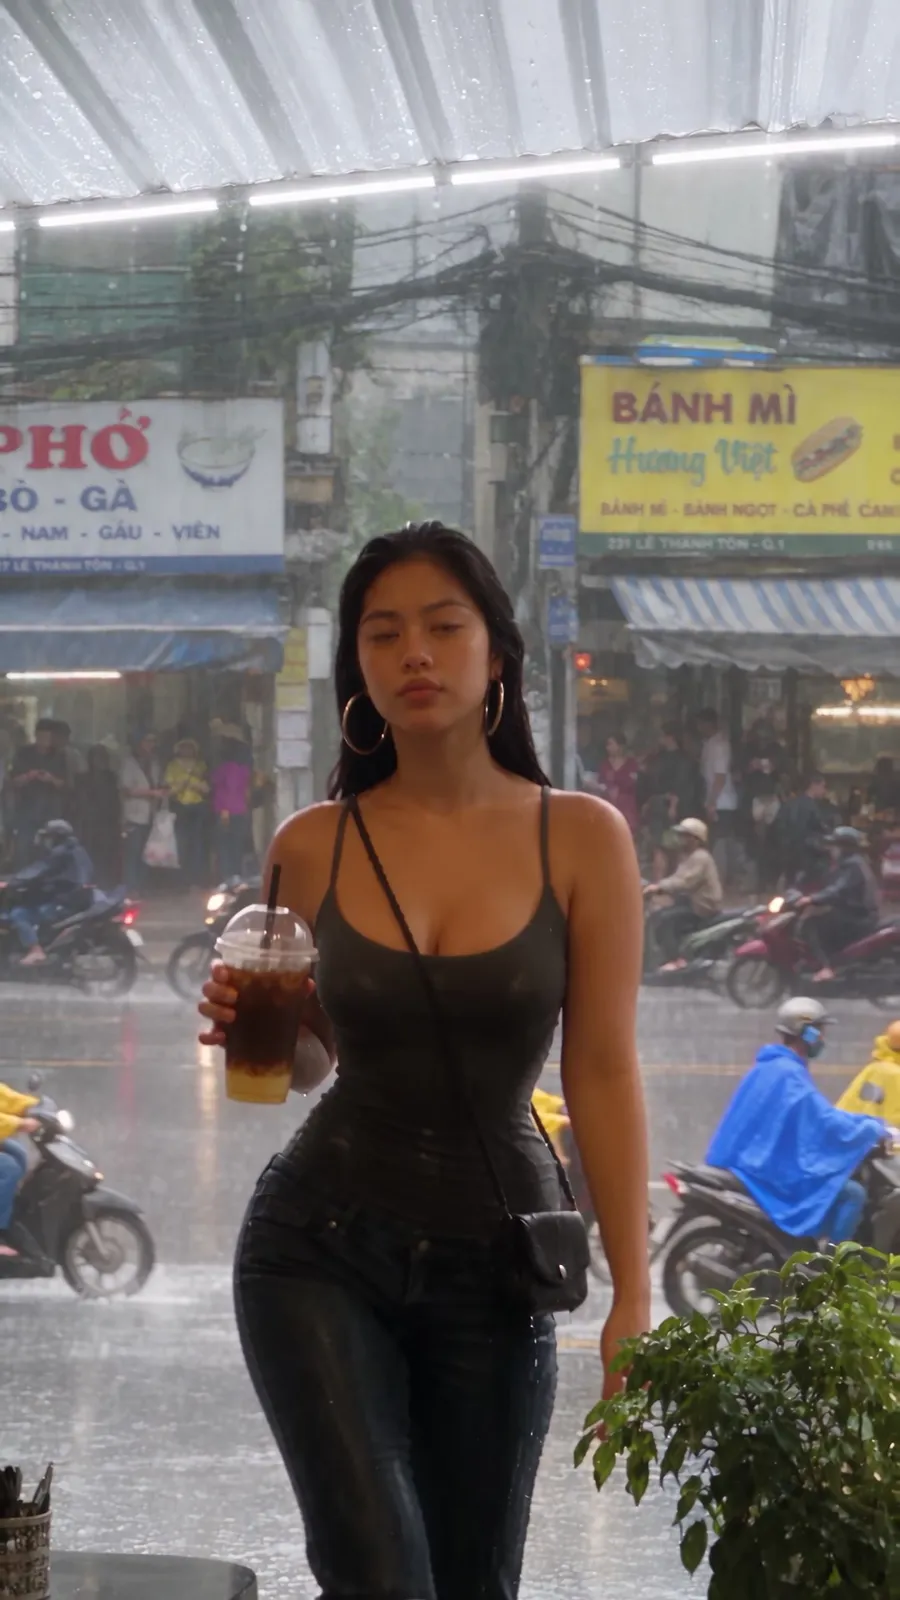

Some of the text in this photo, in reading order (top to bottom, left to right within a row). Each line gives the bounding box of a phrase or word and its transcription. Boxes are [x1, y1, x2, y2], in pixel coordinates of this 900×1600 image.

[612, 381, 796, 425] BÁNH MÌ
[80, 478, 138, 512] GÀ
[21, 526, 68, 541] NAM
[172, 521, 219, 541] VIÊN
